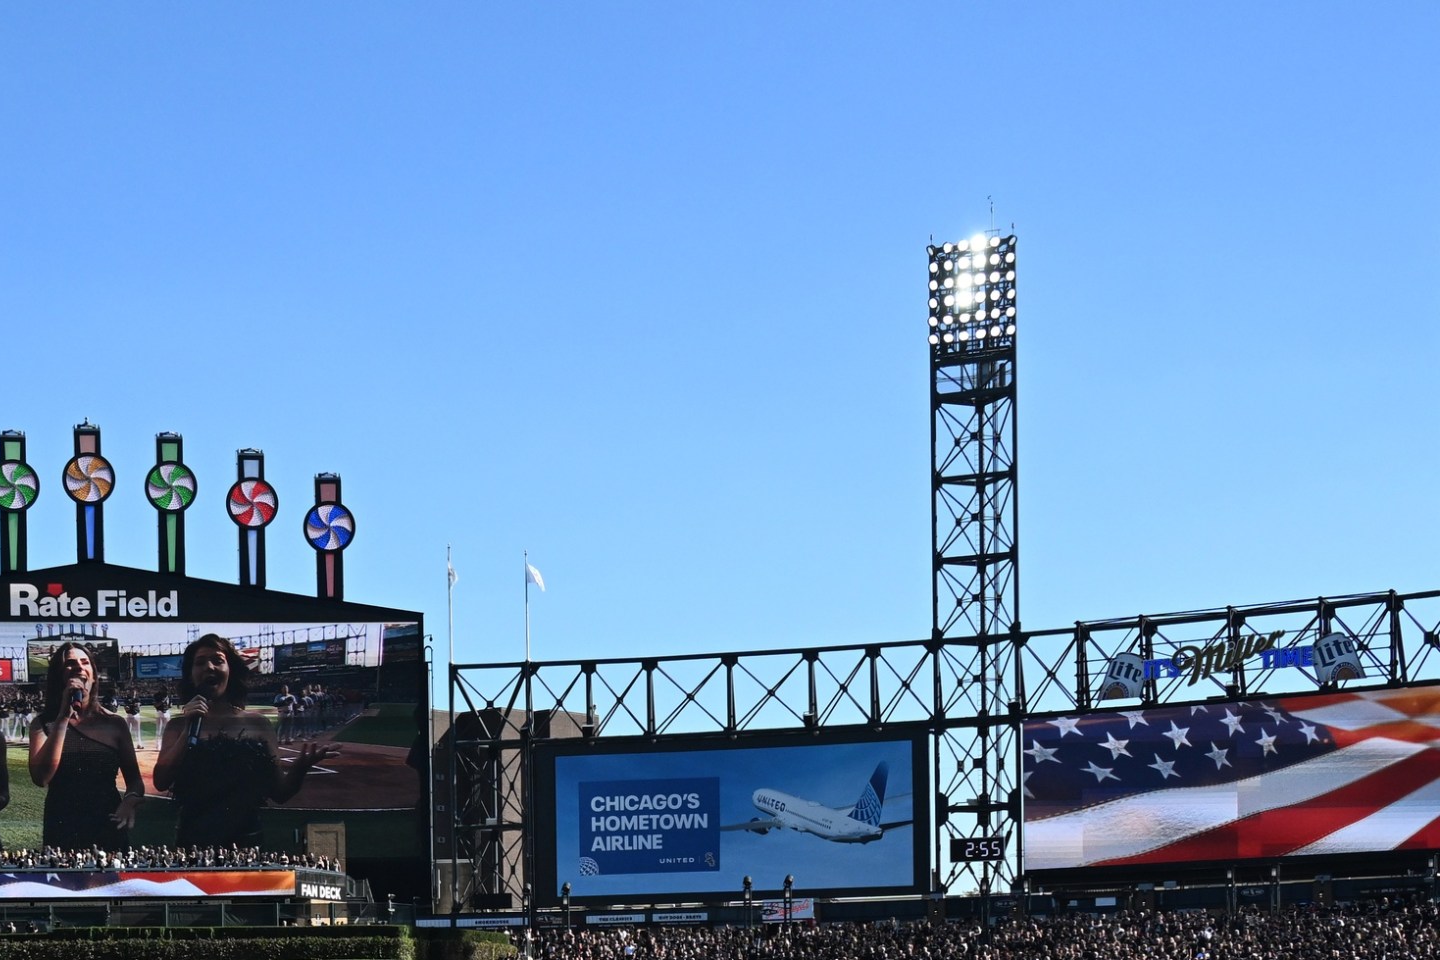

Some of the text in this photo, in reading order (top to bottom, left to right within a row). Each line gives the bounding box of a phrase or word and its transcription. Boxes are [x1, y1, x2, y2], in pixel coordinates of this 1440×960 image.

[9, 583, 179, 617] Rate Field
[1172, 630, 1285, 687] Miller
[1260, 645, 1312, 670] TIME
[1316, 637, 1353, 667] Lite
[1110, 660, 1143, 683] Lite
[590, 793, 701, 812] CHICAGO'S
[757, 794, 786, 813] UNITED
[591, 813, 709, 832] HOMETOWN
[590, 834, 663, 852] AIRLINE
[965, 841, 1001, 858] 2:55
[301, 884, 342, 900] FAN DECK
